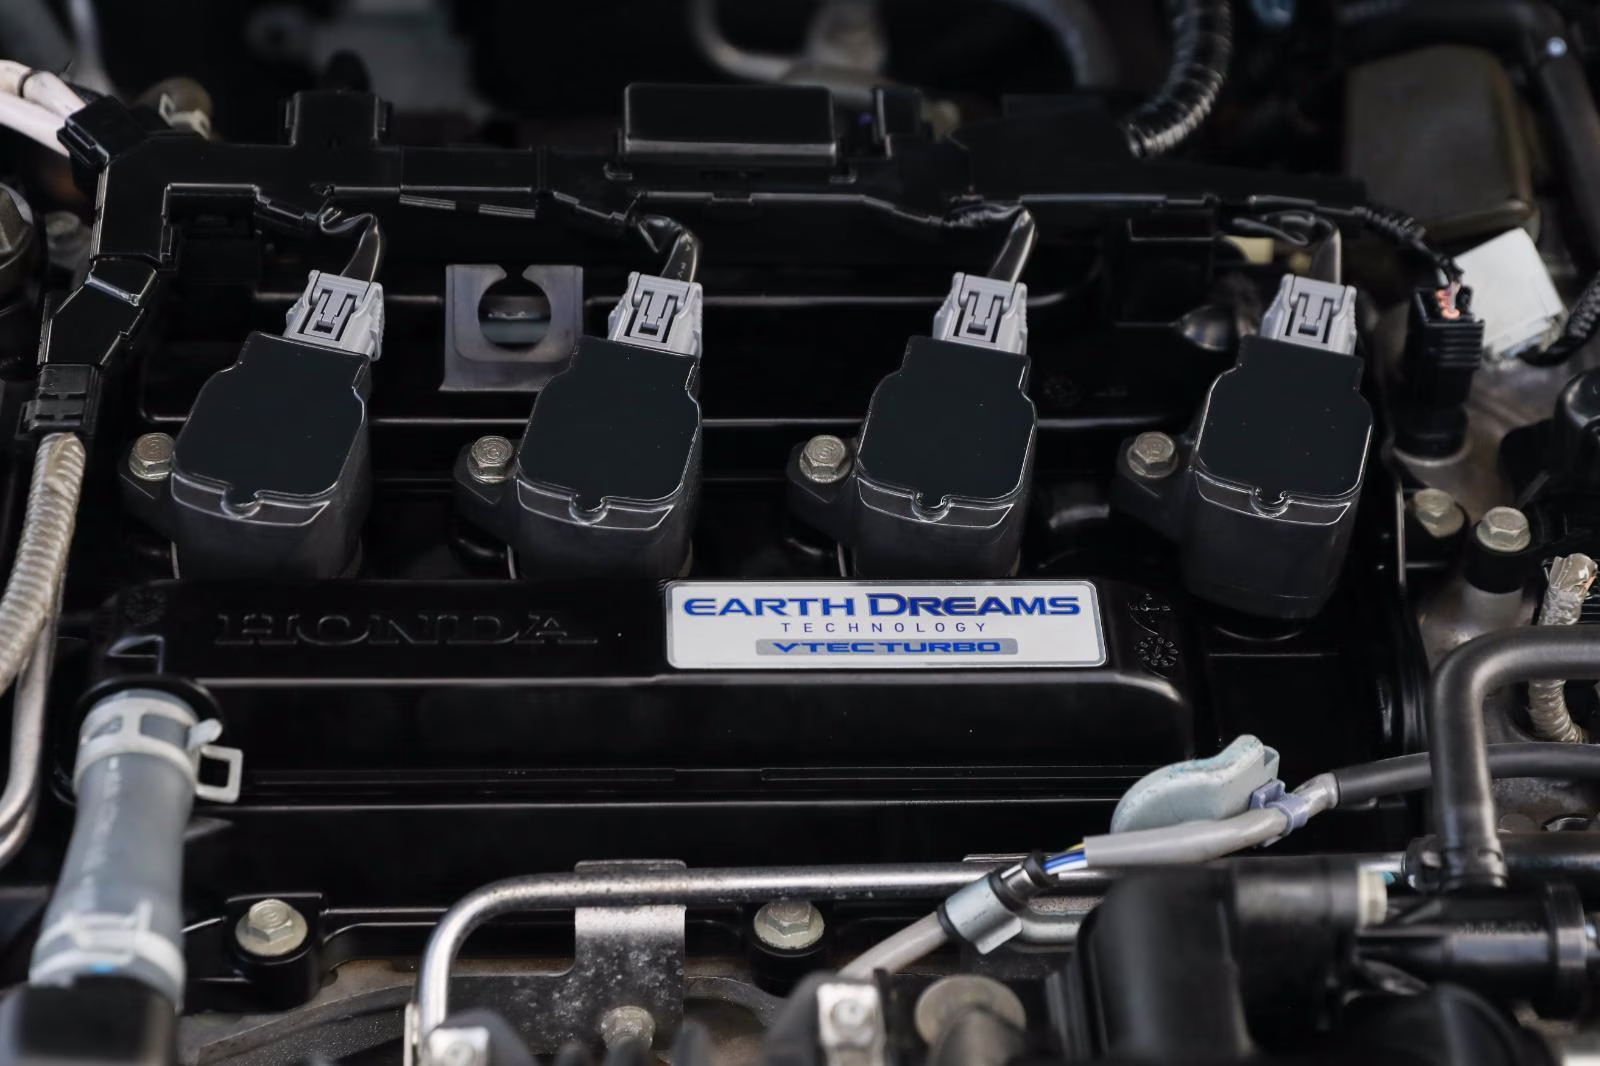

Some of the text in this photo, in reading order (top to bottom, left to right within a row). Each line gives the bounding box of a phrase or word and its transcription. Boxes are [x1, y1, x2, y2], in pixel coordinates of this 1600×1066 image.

[683, 593, 1081, 617] EARTH DREAMS
[214, 613, 598, 646] HONDA
[781, 622, 985, 633] TECHNOLOGY
